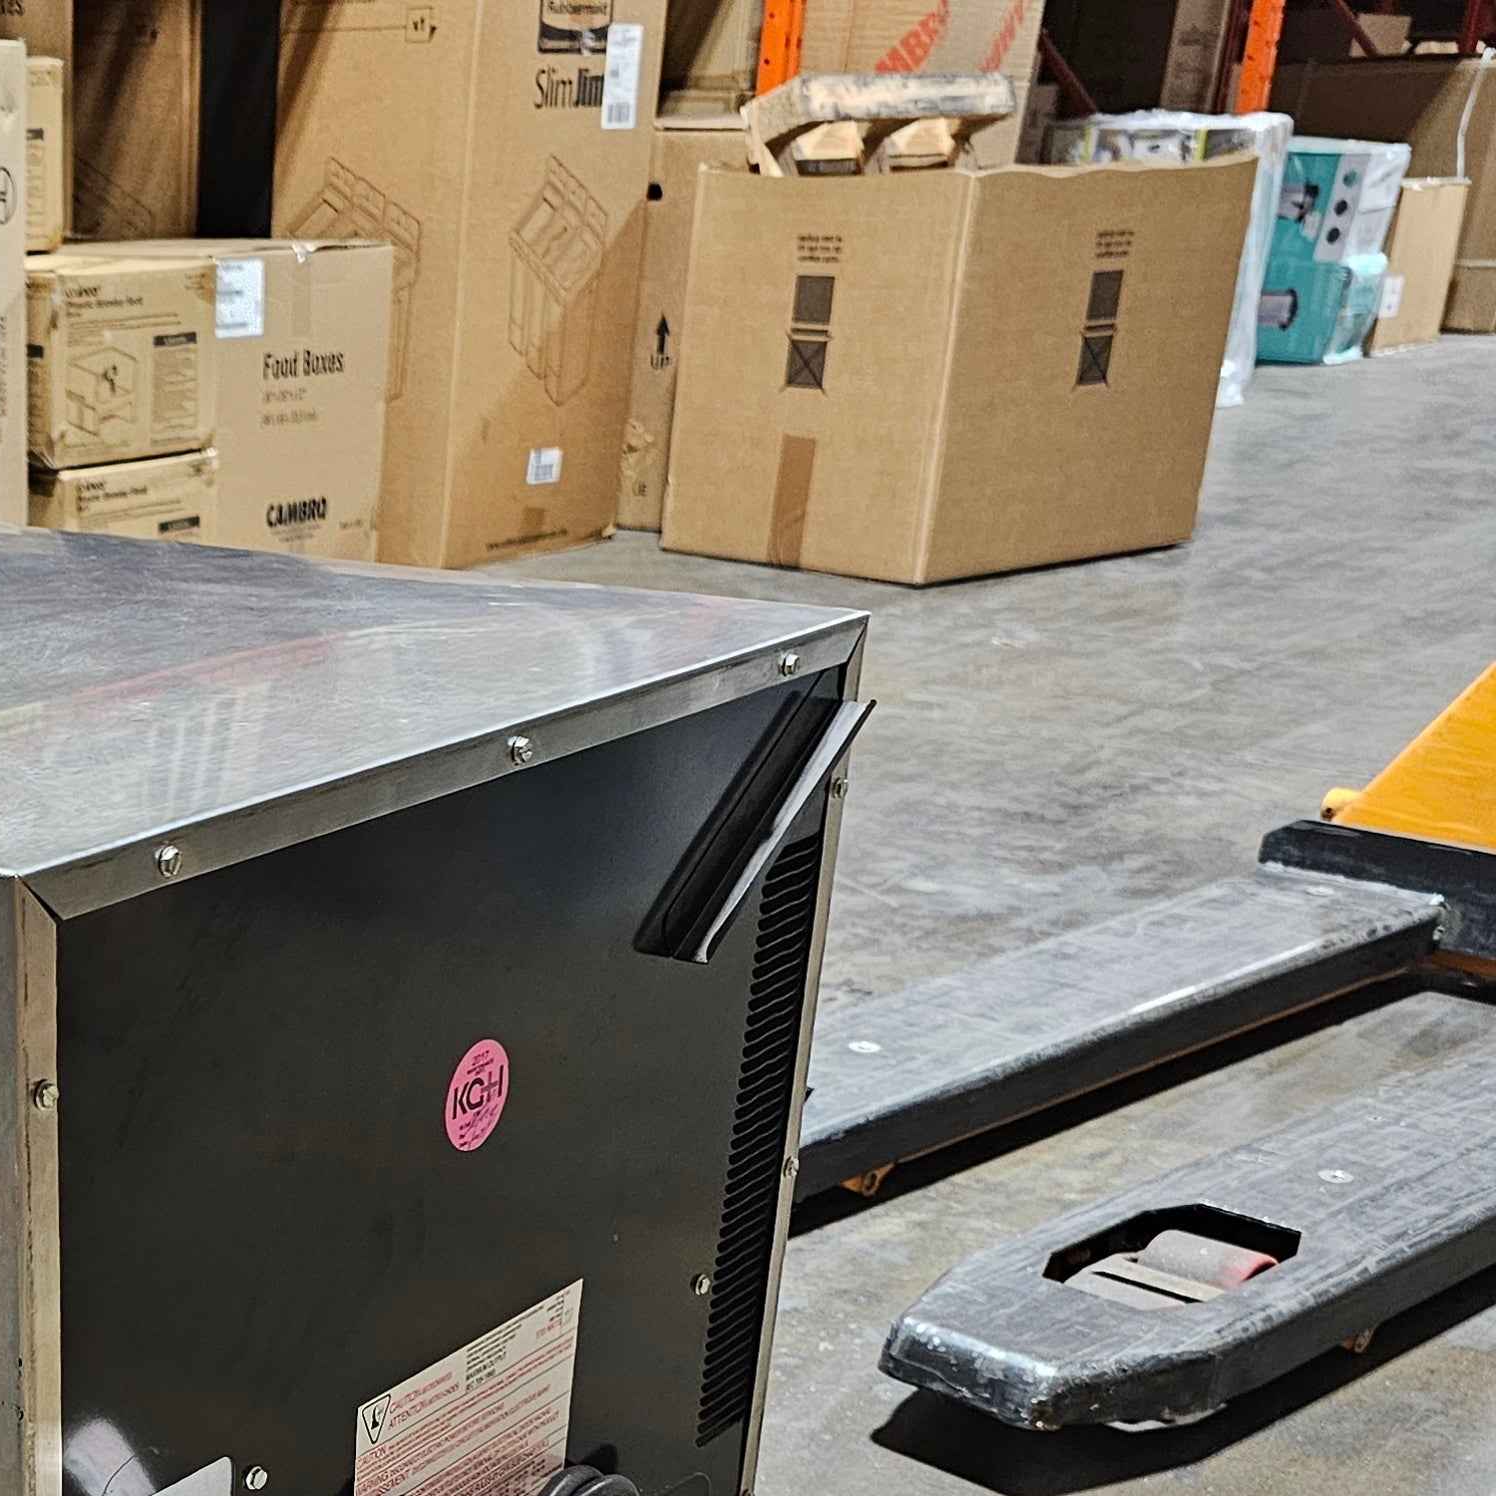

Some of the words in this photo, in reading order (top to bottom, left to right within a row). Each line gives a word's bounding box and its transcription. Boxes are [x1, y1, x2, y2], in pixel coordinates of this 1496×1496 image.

[533, 63, 573, 109] Slim
[263, 350, 299, 380] Food
[303, 349, 344, 376] Boxes
[266, 495, 327, 528] CAMBRO
